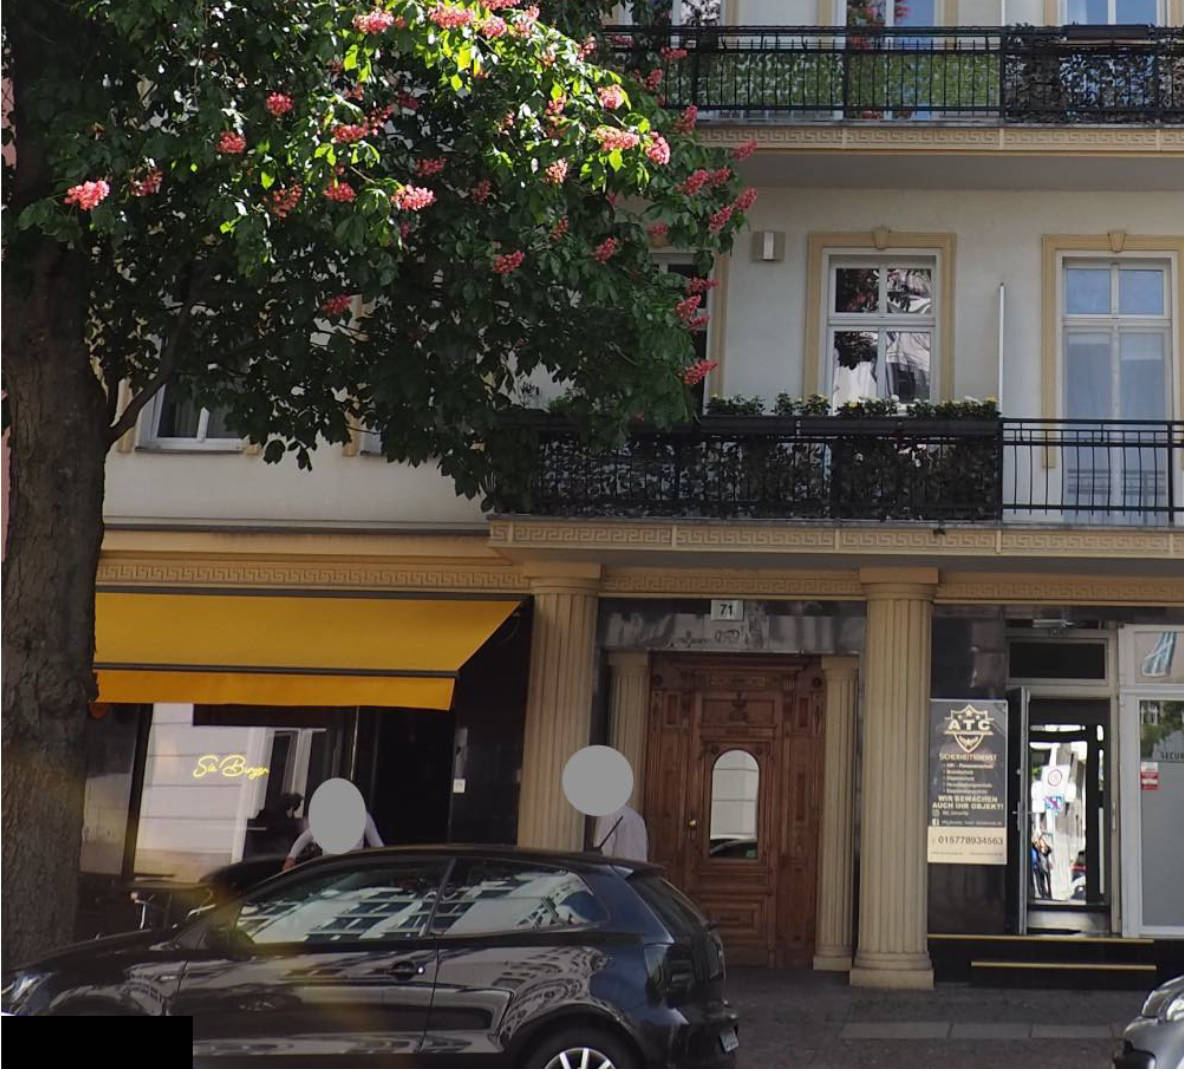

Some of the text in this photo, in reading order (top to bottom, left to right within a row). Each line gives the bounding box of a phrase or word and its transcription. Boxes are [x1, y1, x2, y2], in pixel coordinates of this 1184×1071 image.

[720, 604, 732, 616] 71
[948, 719, 991, 731] ATC
[954, 795, 998, 803] BEWACHEN
[932, 801, 953, 809] AUCH
